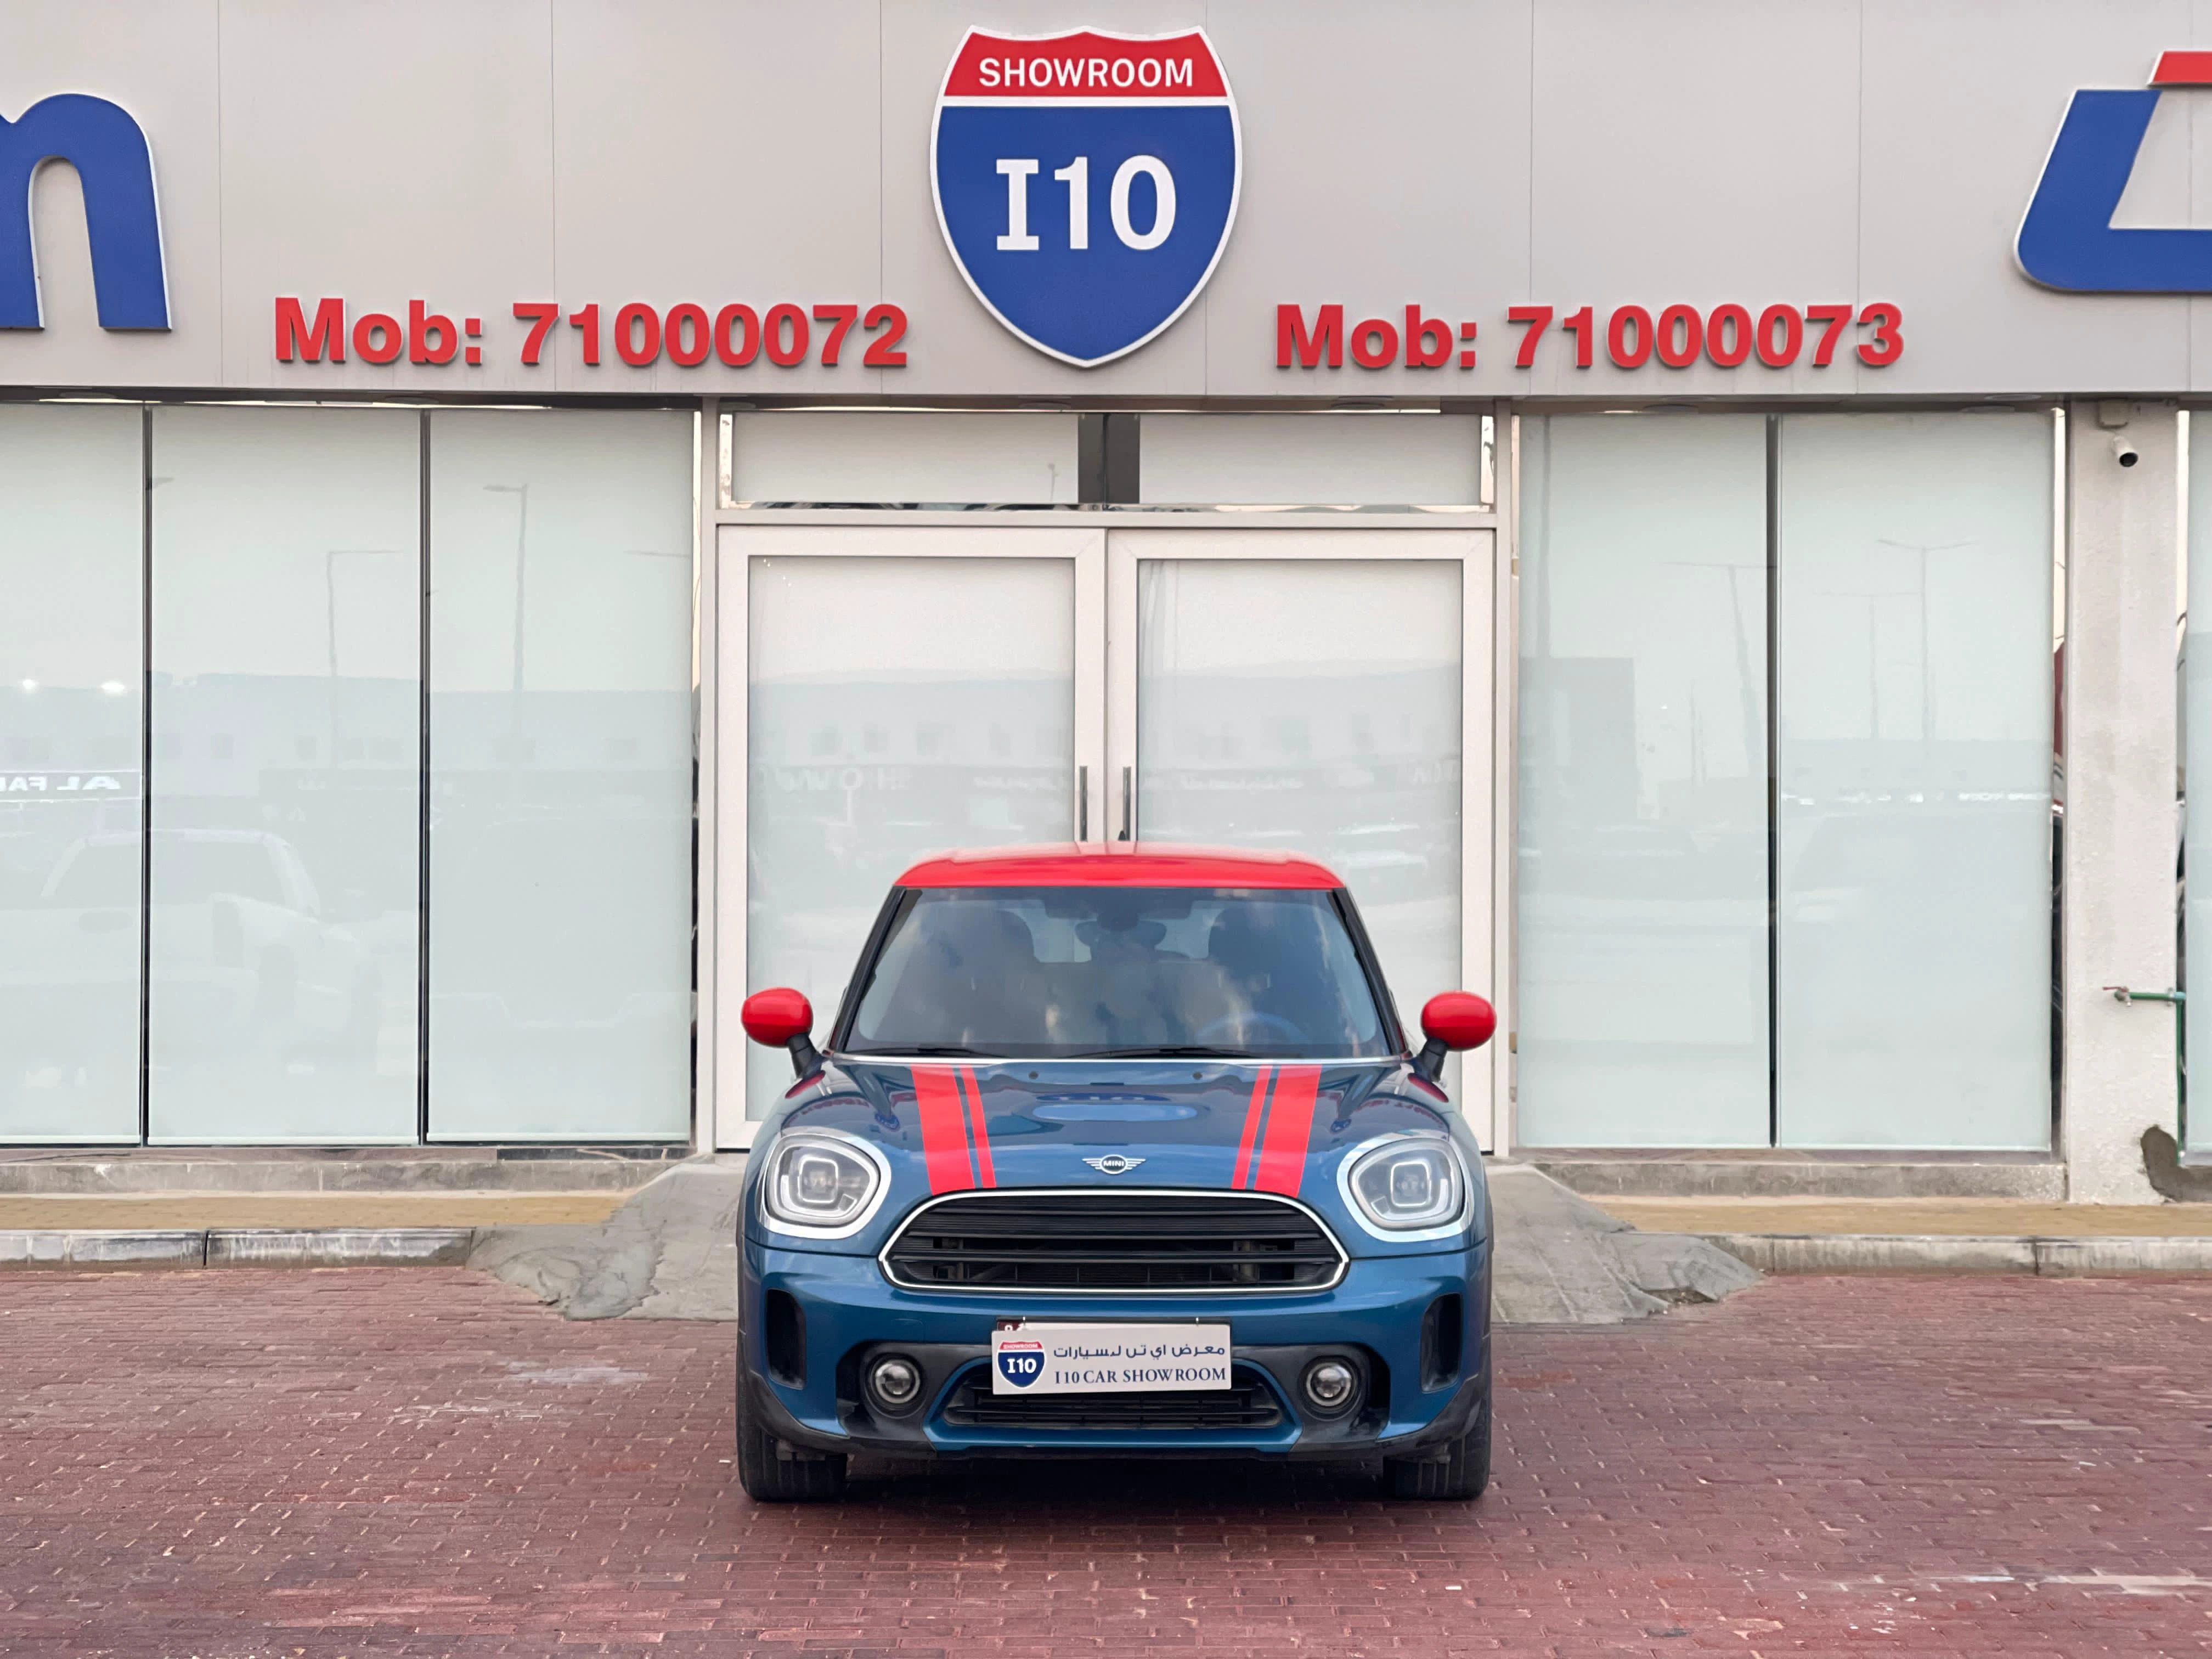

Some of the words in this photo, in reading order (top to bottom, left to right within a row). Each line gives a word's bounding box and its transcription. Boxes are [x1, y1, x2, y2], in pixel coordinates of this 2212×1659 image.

[979, 58, 1193, 88] SHOWROOM
[996, 154, 1176, 250] I10
[275, 296, 482, 365] Mob:
[512, 302, 907, 366] 71000072
[1276, 303, 1477, 369] Mob:
[1507, 302, 1904, 369] 71000073
[1172, 1344, 1225, 1357] معرض
[1007, 1358, 1037, 1374] I10
[1084, 1370, 1118, 1383] CAR
[1123, 1368, 1226, 1383] SHOWROOM
